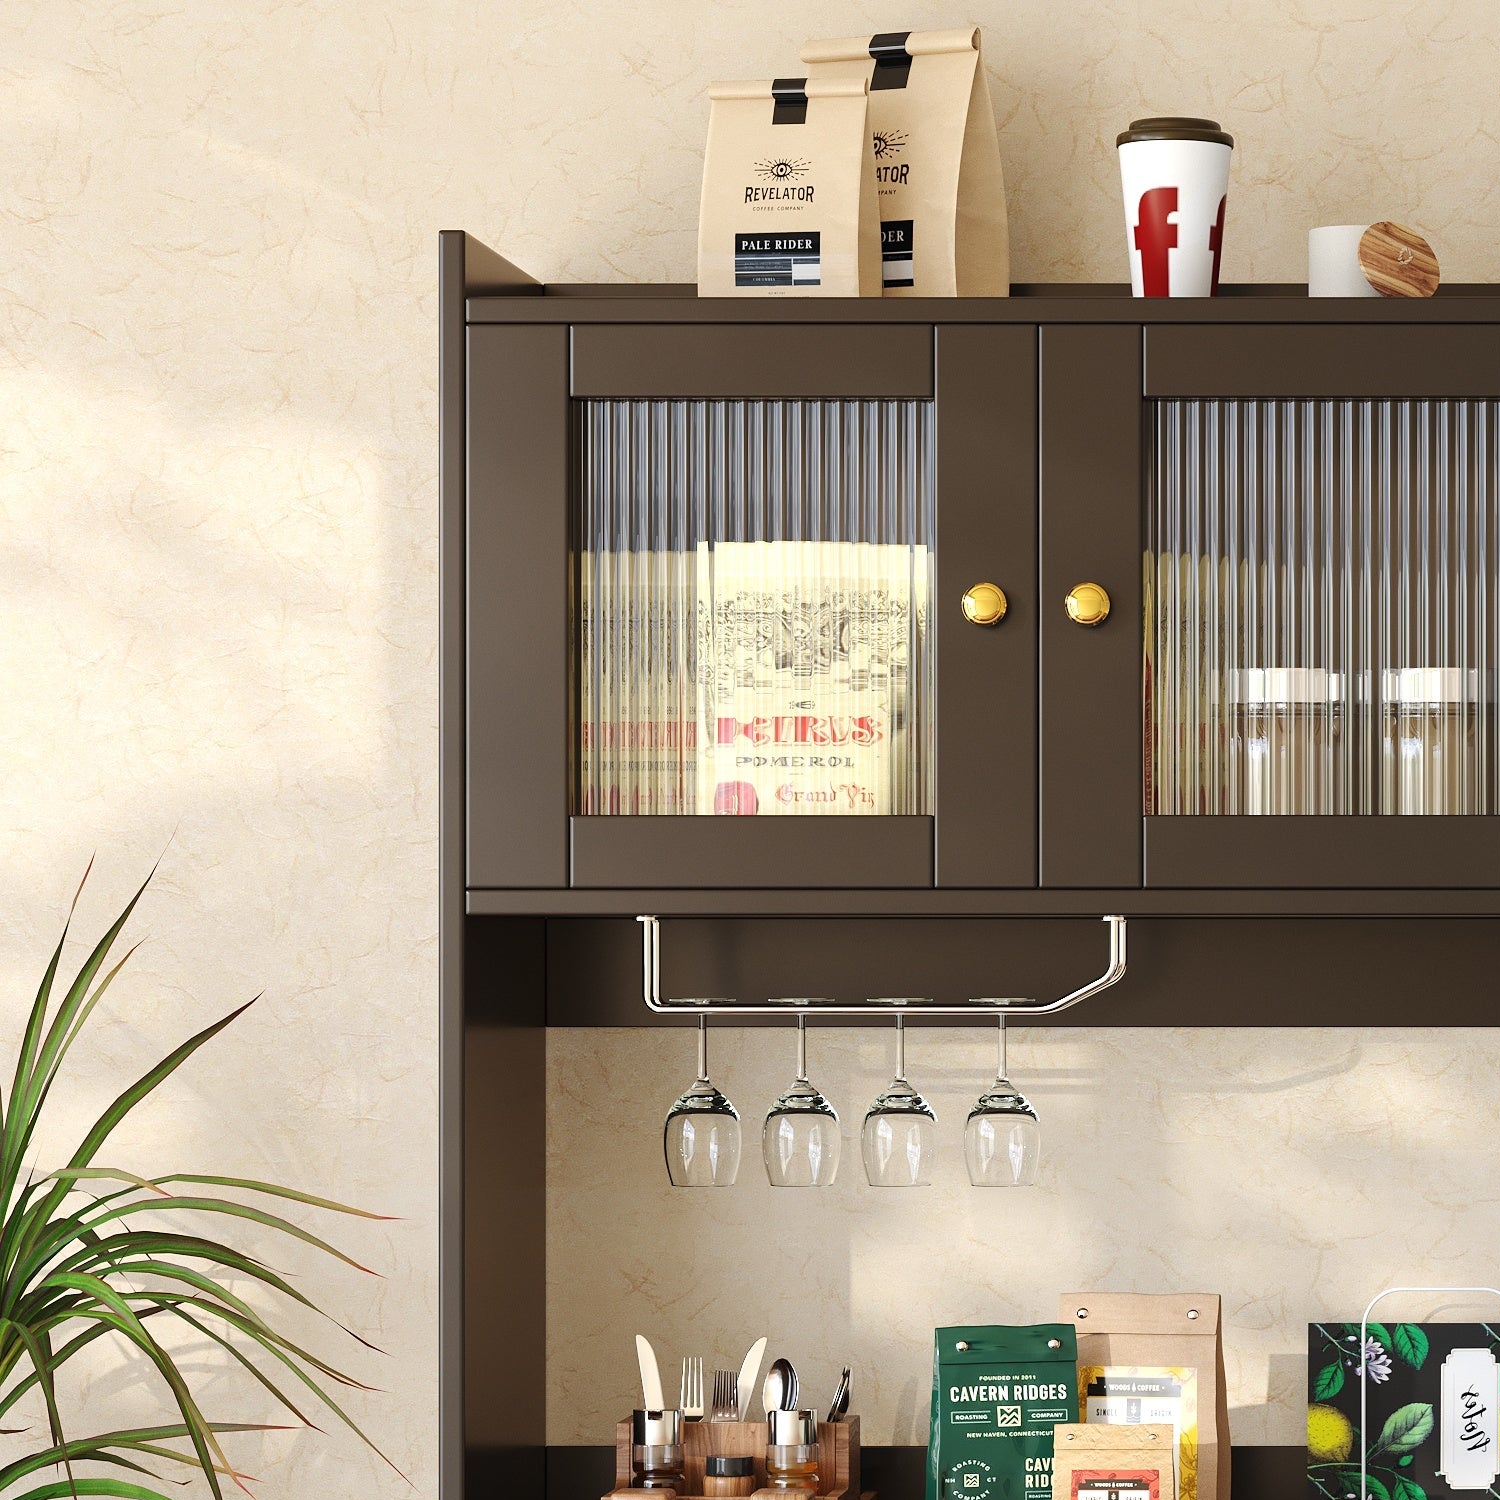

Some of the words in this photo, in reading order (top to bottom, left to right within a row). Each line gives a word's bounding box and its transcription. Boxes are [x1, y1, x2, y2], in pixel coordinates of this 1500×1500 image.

[744, 186, 815, 203] REVELATOR
[742, 241, 771, 250] PALE
[775, 240, 813, 249] RIDER
[736, 757, 855, 768] POMEROL
[950, 1385, 1009, 1402] CAVERN
[1013, 1383, 1067, 1401] RIDGES
[1137, 1384, 1160, 1392] COFFEE
[951, 1459, 991, 1472] ROASTING
[1025, 1458, 1054, 1472] CAV
[1025, 1474, 1053, 1488] RID
[952, 1490, 990, 1500] COMPANY
